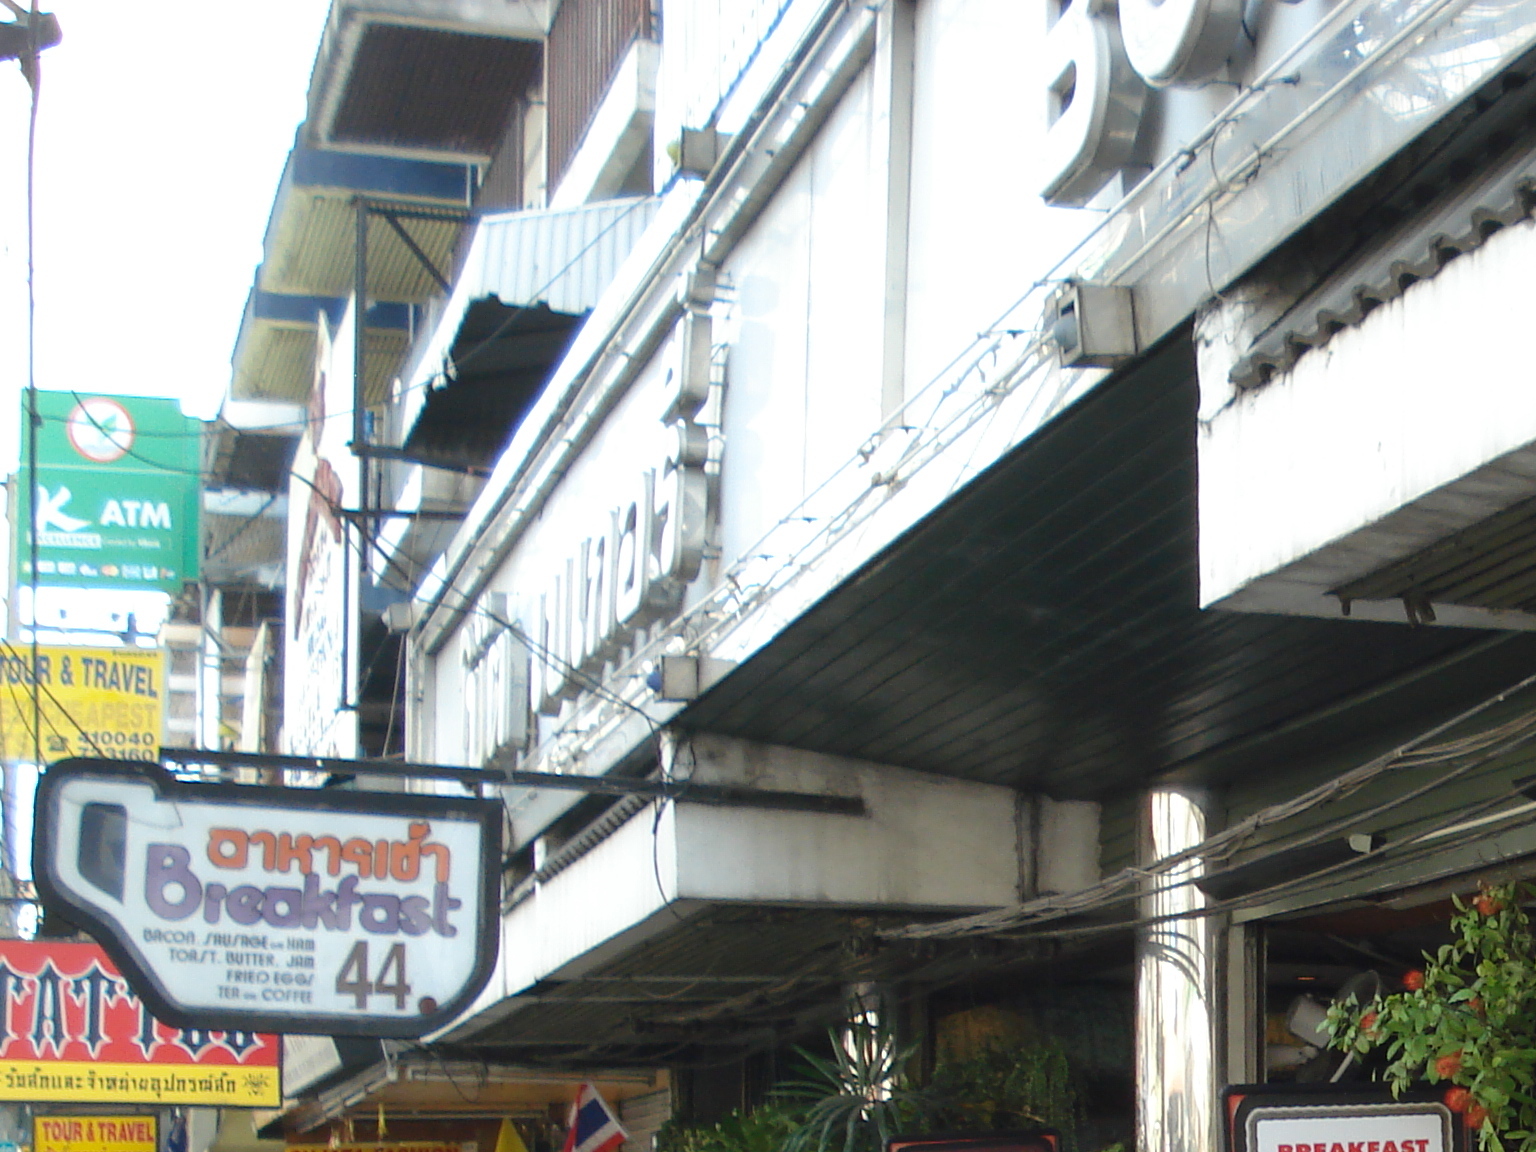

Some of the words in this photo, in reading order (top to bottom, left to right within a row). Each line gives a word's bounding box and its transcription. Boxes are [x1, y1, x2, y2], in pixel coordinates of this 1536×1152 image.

[101, 500, 171, 529] ATM
[61, 655, 73, 685] &
[82, 657, 157, 698] TRAVEL
[206, 820, 450, 883] อาหารเช้า
[144, 843, 461, 937] Breakfast
[287, 936, 315, 950] HAM
[287, 955, 315, 968] JAM
[226, 970, 269, 983] FRIED
[273, 972, 315, 986] EGGS
[218, 986, 240, 999] TEA
[261, 989, 313, 1004] COFFEE
[42, 1121, 82, 1142] TOUR
[87, 1121, 95, 1141] &
[98, 1122, 154, 1142] TRAVEL
